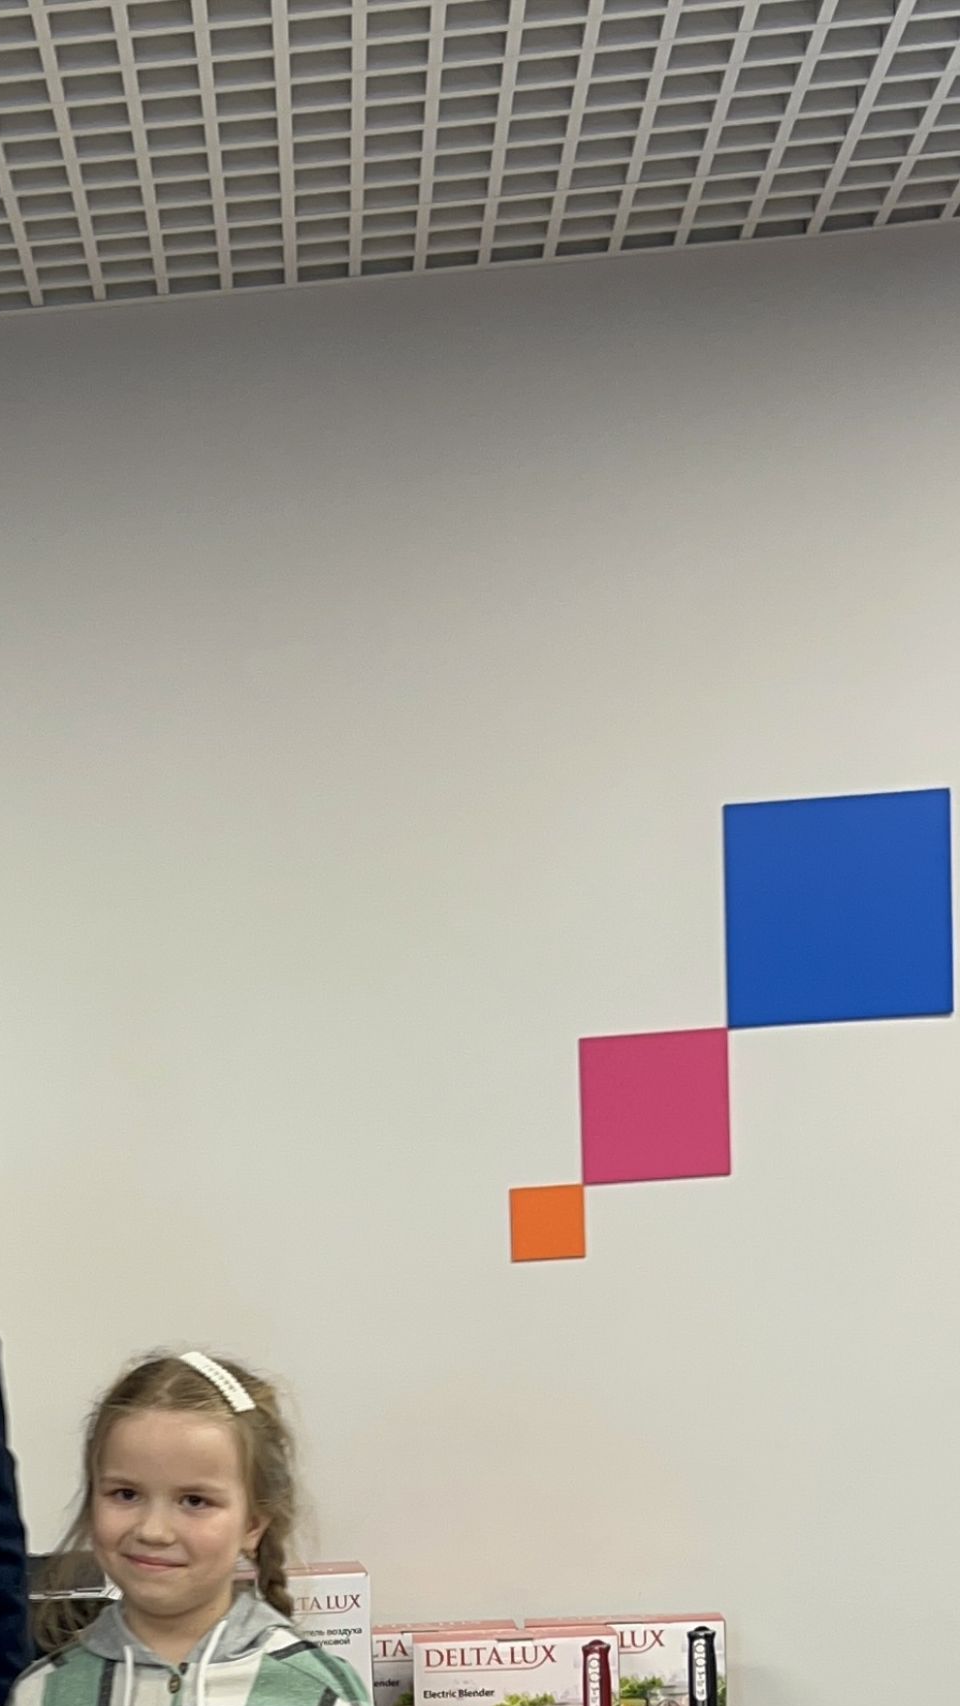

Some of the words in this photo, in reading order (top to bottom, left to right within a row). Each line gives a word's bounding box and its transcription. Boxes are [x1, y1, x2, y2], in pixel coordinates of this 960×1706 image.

[326, 1594, 361, 1609] LUX
[619, 1629, 665, 1649] LUX
[424, 1646, 505, 1668] DELTA
[509, 1644, 558, 1665] LUX
[423, 1689, 456, 1700] Electric
[458, 1688, 495, 1699] Blender
